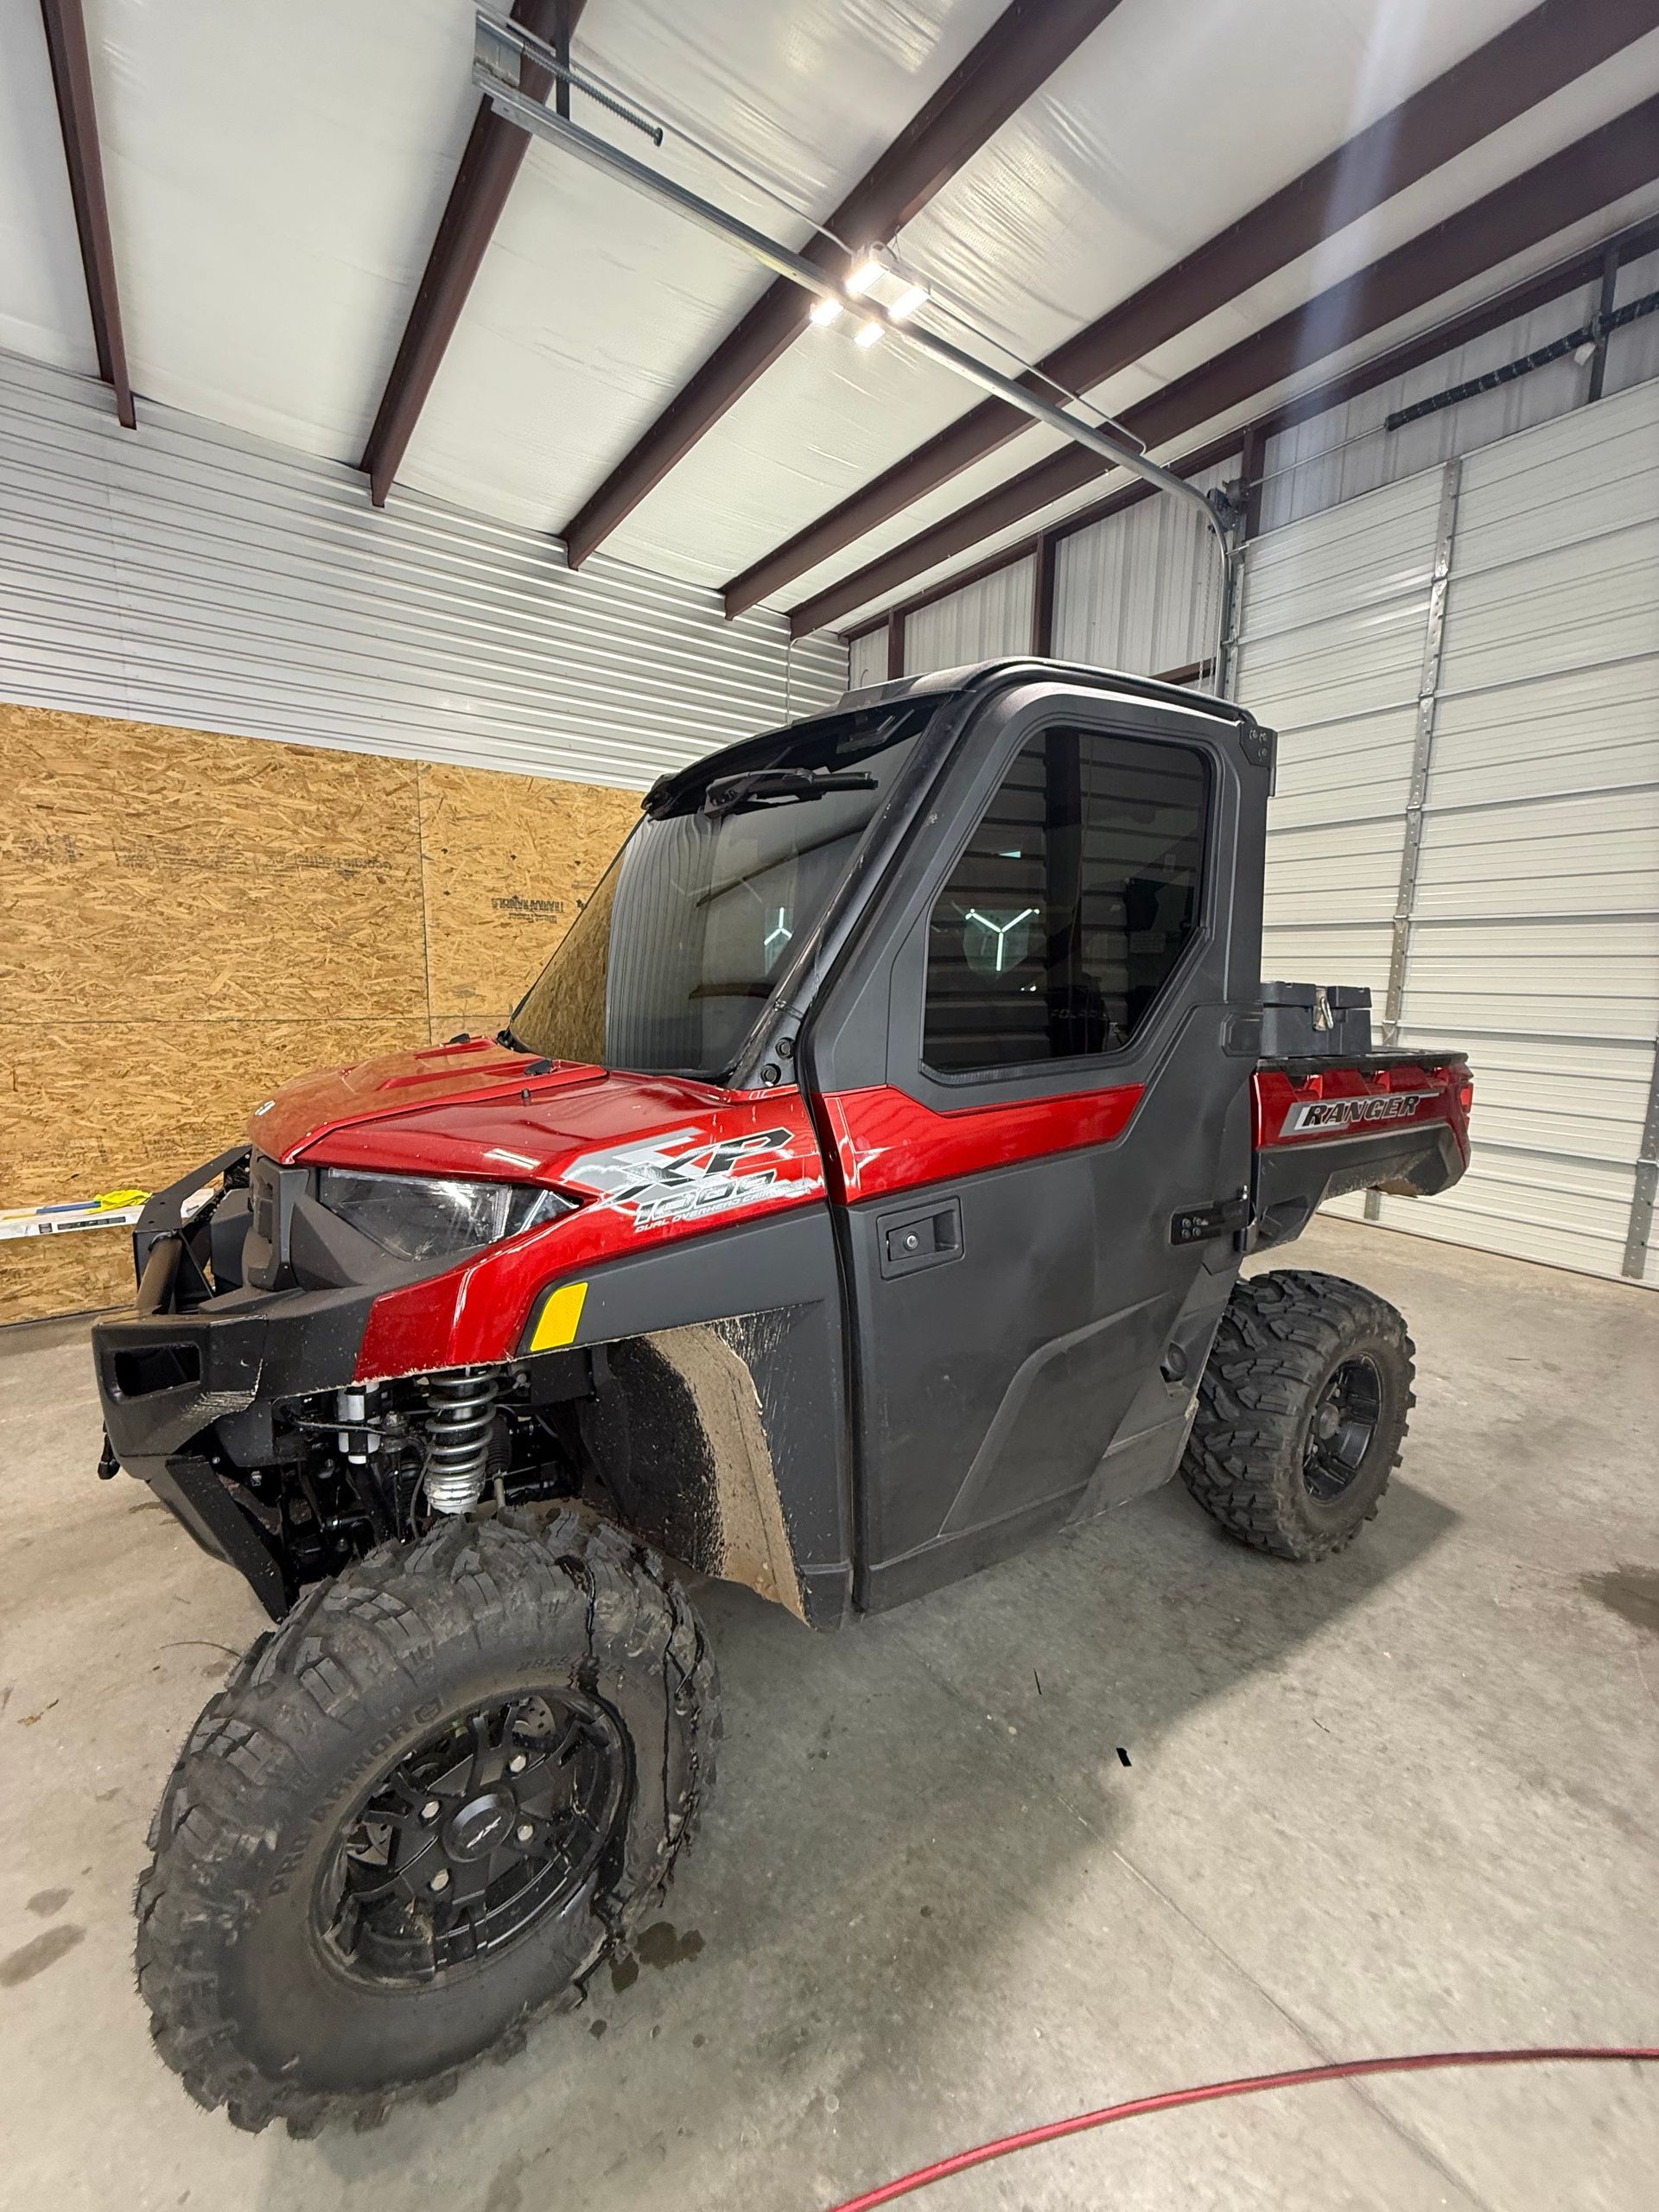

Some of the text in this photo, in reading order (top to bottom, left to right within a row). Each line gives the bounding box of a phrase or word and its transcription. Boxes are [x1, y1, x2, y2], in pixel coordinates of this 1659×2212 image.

[1302, 1096, 1420, 1127] RANGER
[603, 1127, 795, 1208] XP
[633, 1169, 777, 1227] 1000
[635, 1219, 671, 1233] DUAL
[671, 1198, 740, 1224] OVERHEAD
